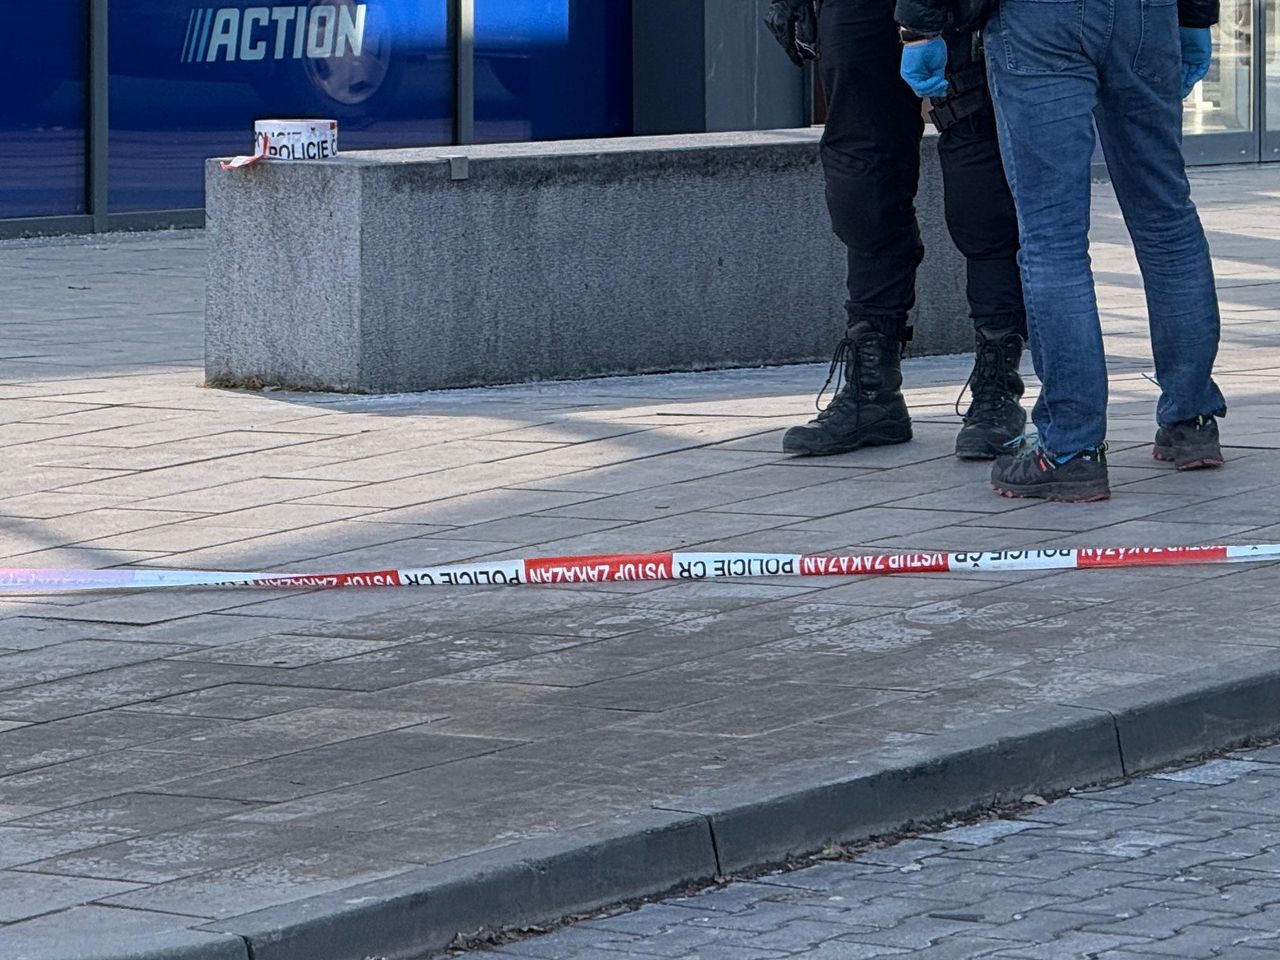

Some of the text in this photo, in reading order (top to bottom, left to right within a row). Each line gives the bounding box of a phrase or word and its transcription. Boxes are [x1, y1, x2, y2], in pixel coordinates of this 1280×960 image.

[206, 4, 366, 63] ACTION
[440, 568, 520, 587] POLICIE
[613, 563, 666, 581] VSTUP
[714, 558, 794, 578] POLICIE
